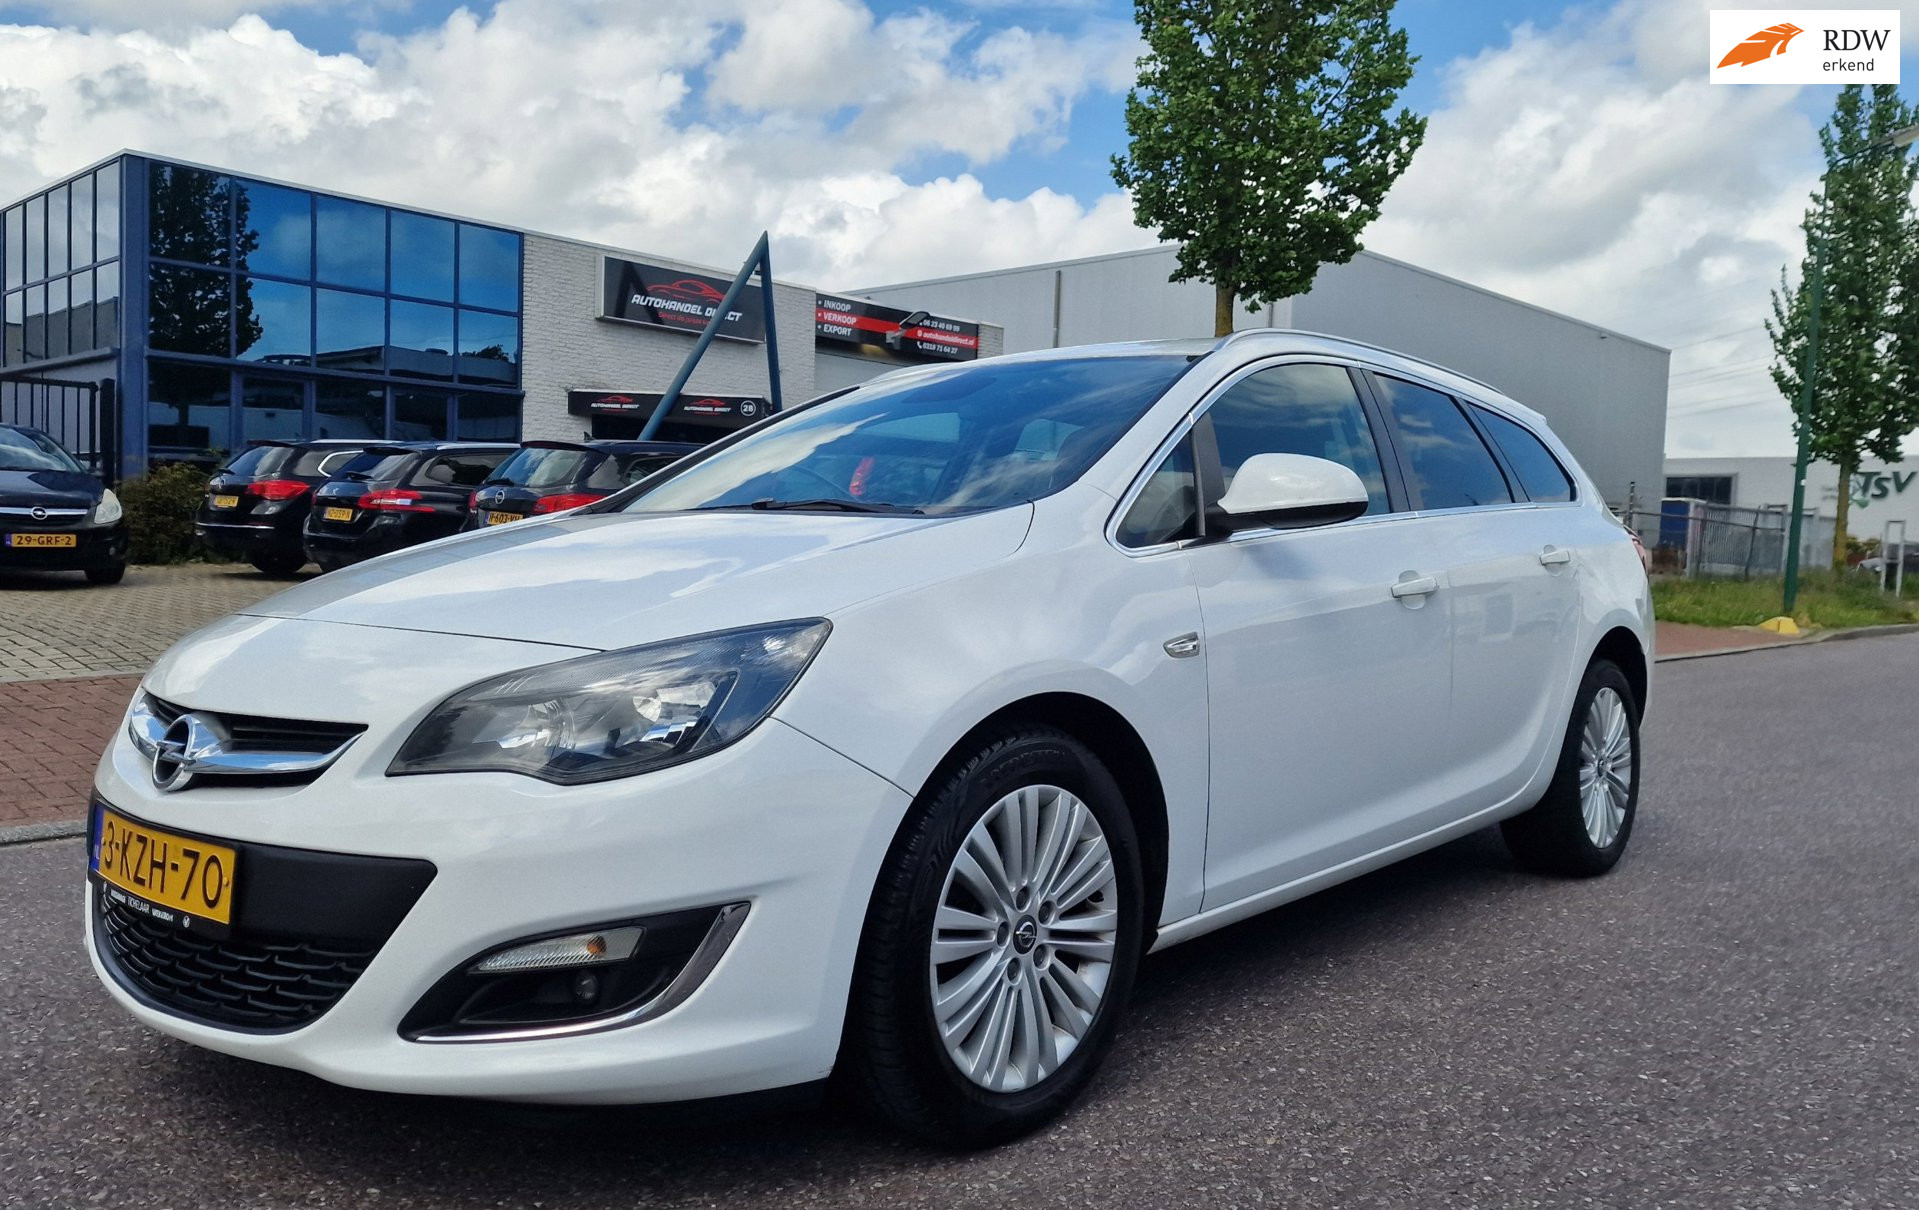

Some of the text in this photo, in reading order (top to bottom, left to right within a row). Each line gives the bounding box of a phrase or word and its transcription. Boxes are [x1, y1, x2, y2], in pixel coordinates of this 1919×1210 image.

[631, 294, 743, 322] AUTOHANDEL DICT
[823, 300, 851, 312] INKOOP
[823, 312, 857, 326] VERKOOP
[823, 324, 852, 336] EXPORT
[16, 535, 72, 546] 29-GRF-2
[104, 821, 223, 909] 3-KZH-70
